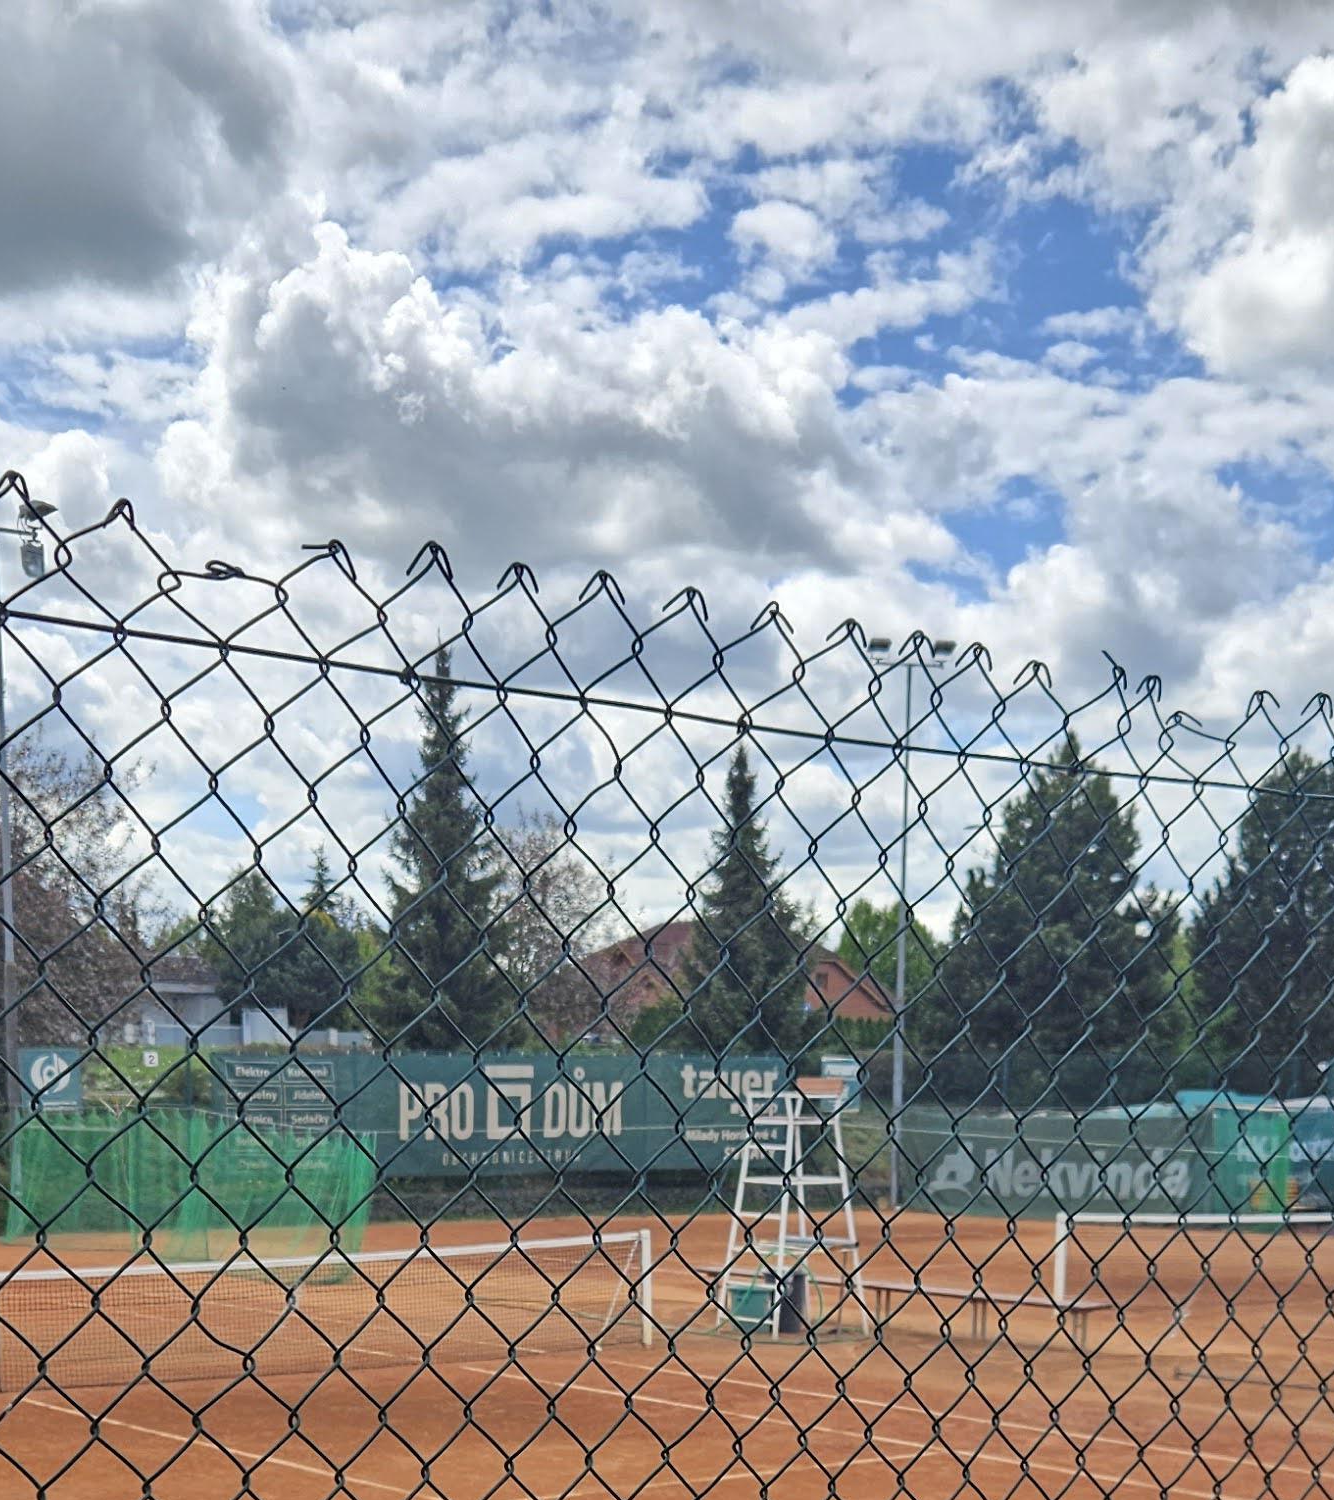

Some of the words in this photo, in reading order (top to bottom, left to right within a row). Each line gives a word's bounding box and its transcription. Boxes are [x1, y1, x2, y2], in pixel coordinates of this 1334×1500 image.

[399, 1082, 474, 1141] PRO
[543, 1067, 624, 1138] DŮM
[680, 1064, 779, 1099] tauer
[983, 1148, 1192, 1202] Nekvinda
